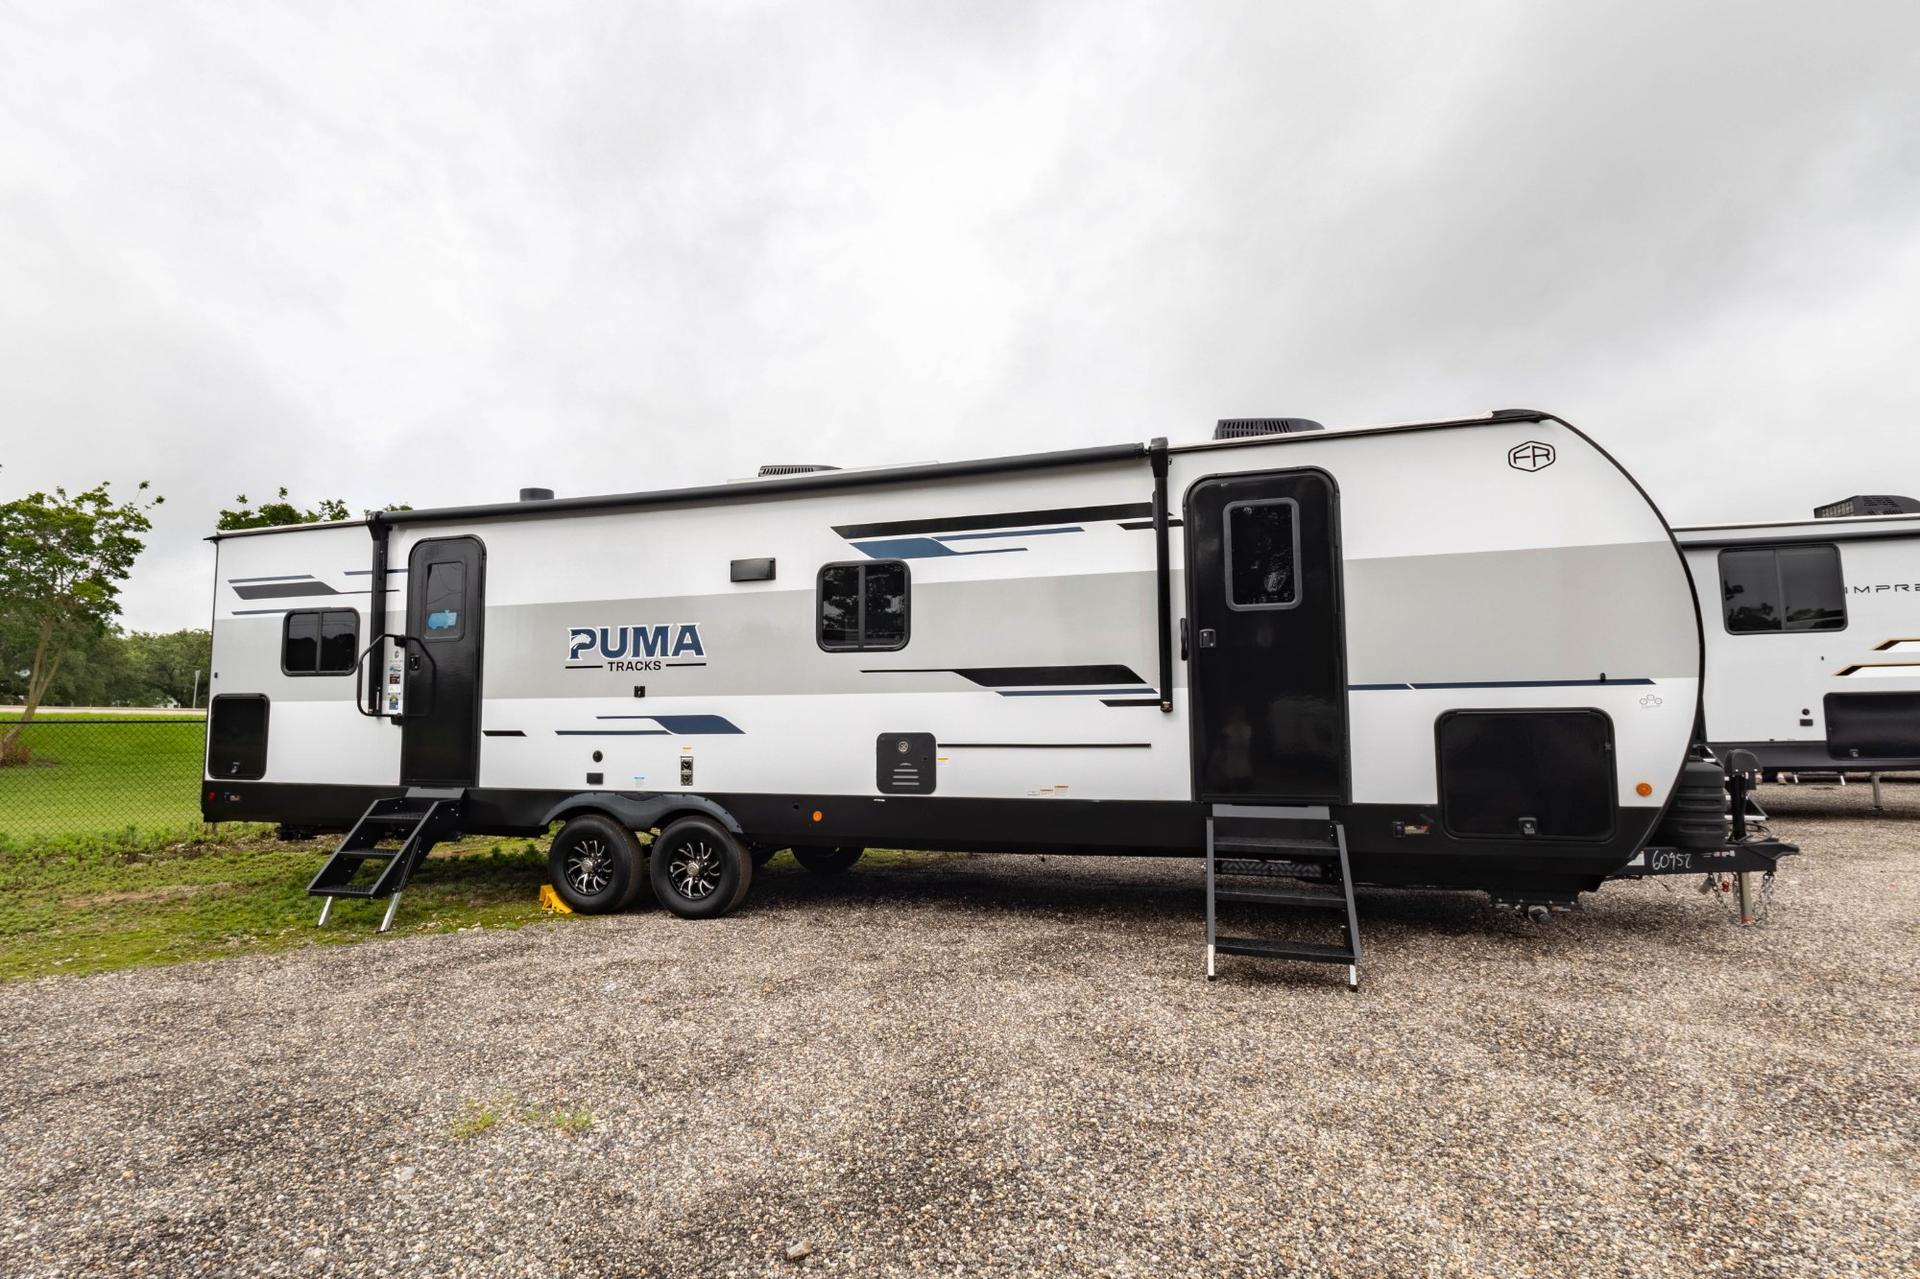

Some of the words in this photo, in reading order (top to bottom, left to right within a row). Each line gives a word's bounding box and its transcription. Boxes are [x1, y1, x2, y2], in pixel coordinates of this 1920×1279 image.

[1513, 445, 1551, 468] FR
[567, 623, 706, 660] PUMA
[607, 660, 662, 672] TRACKS
